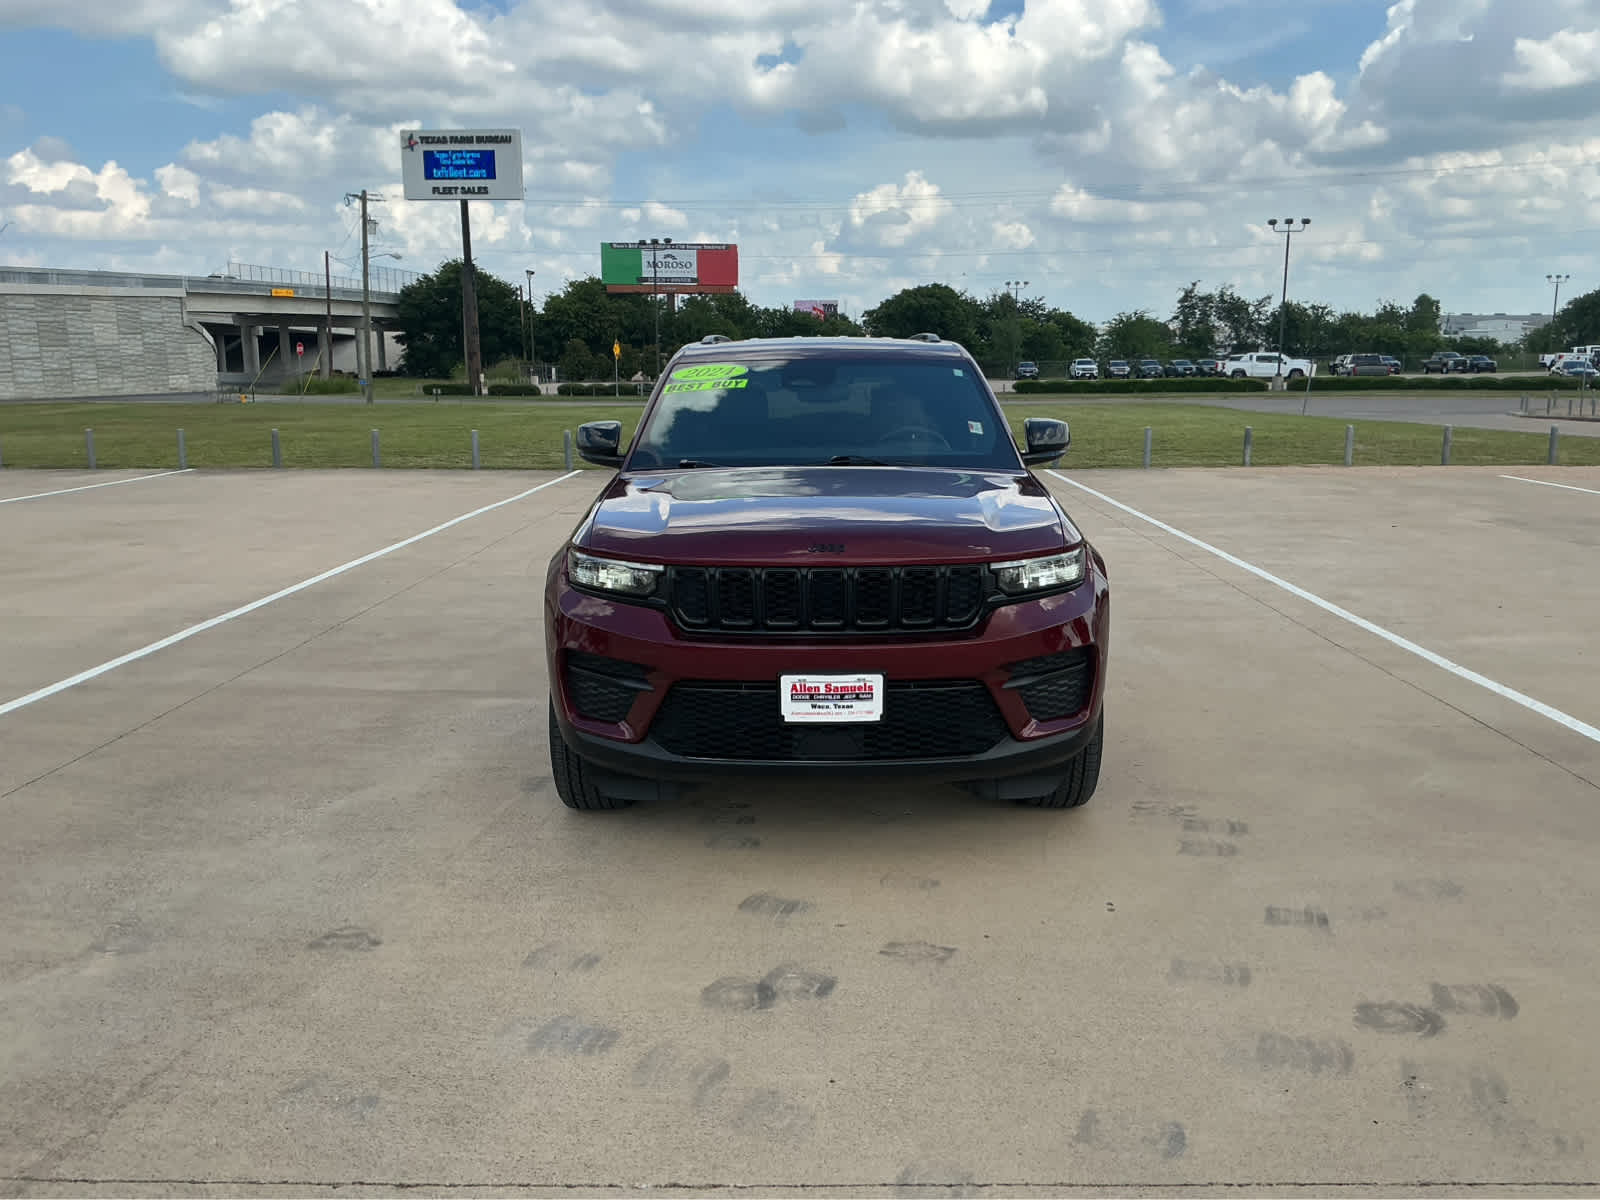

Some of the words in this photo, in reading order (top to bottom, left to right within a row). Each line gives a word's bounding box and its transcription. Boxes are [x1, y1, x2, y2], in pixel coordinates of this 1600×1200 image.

[419, 135, 448, 144] TEXAS
[449, 135, 474, 144] FARM
[476, 135, 512, 144] BUREAU
[432, 186, 459, 195] FLEET
[460, 186, 489, 195] SALES
[647, 260, 692, 269] MOROSO
[682, 366, 736, 378] 2024
[666, 382, 705, 392] BEST
[711, 380, 744, 388] BUY
[791, 683, 820, 693] Allen
[824, 682, 874, 693] Samuels
